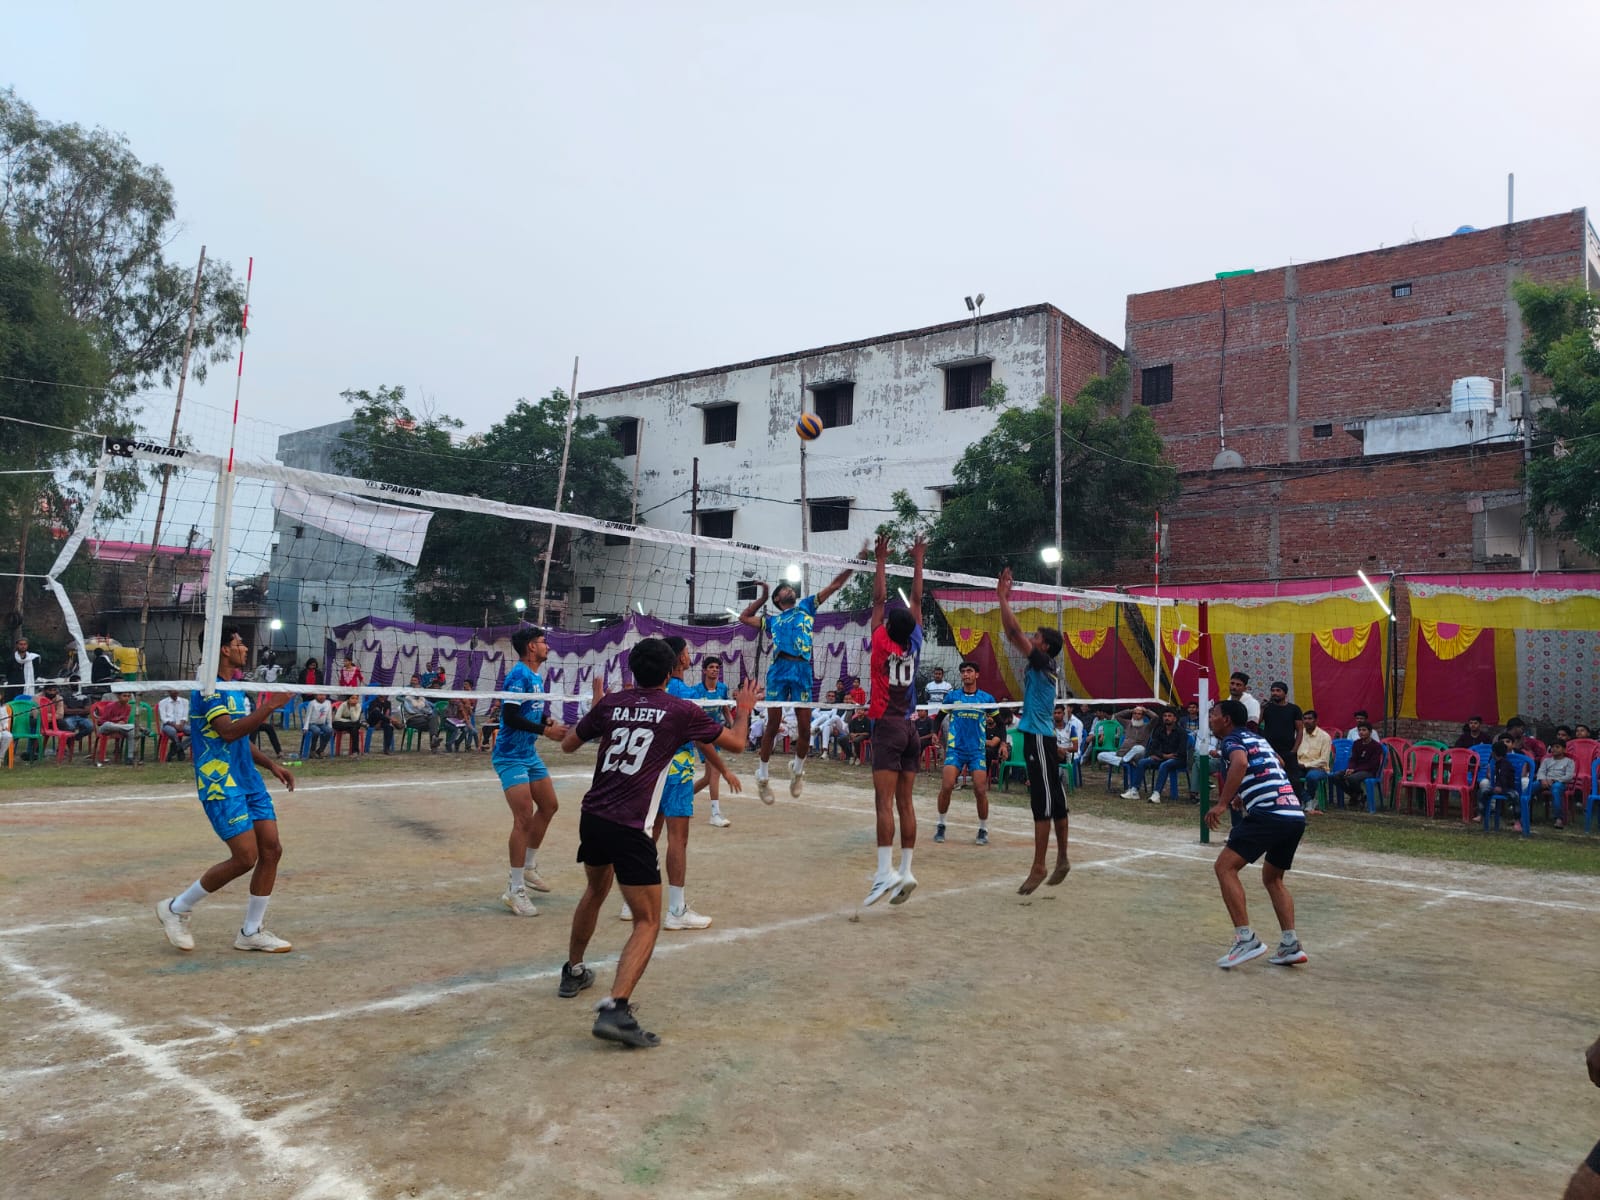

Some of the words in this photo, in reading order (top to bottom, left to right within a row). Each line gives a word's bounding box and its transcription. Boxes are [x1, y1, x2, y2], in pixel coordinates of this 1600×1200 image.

[133, 442, 187, 458] SPARTAN
[380, 483, 423, 496] SPARTAN
[888, 653, 915, 686] 10
[612, 707, 667, 724] RAJEEV
[601, 727, 655, 776] 29
